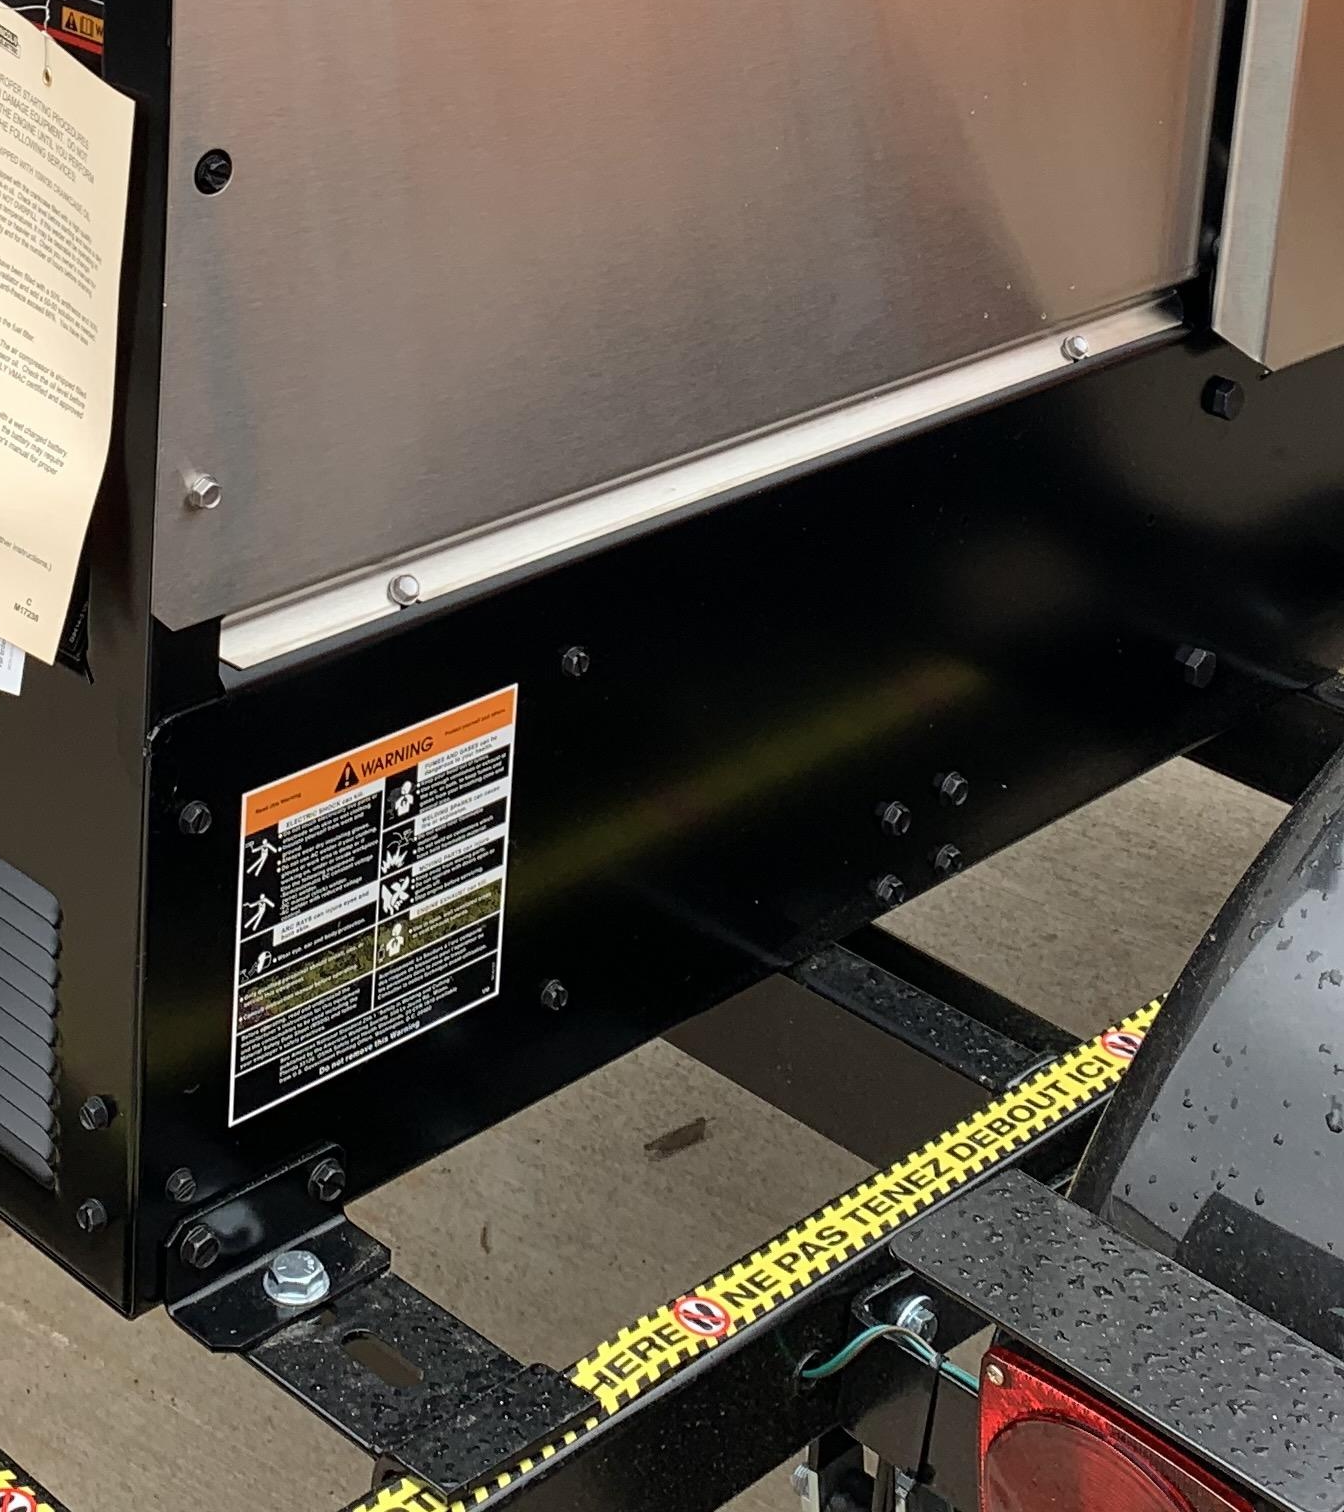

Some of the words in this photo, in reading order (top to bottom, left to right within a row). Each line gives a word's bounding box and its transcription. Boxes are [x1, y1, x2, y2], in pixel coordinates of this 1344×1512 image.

[0, 103, 12, 121] THE
[13, 113, 41, 138] ENGINE
[37, 129, 55, 151] UNTIL
[54, 141, 69, 161] YOU
[68, 152, 95, 184] PERFORM
[2, 90, 30, 115] DAMAGE
[66, 136, 77, 150] DO
[9, 125, 46, 160] FOLLOWING
[23, 90, 51, 118] STARTING
[52, 110, 89, 151] PROCEDURES
[361, 735, 434, 778] WARNING
[319, 1065, 330, 1076] Do
[331, 1059, 344, 1071] not
[344, 1045, 374, 1063] remove
[373, 1035, 389, 1049] this
[389, 1019, 421, 1043] Warning
[720, 1269, 780, 1309] NE
[773, 1224, 849, 1274] PAS
[840, 1156, 955, 1226] TENEZ
[946, 1078, 1070, 1163] DEBOUT
[1066, 1055, 1116, 1086] ICI
